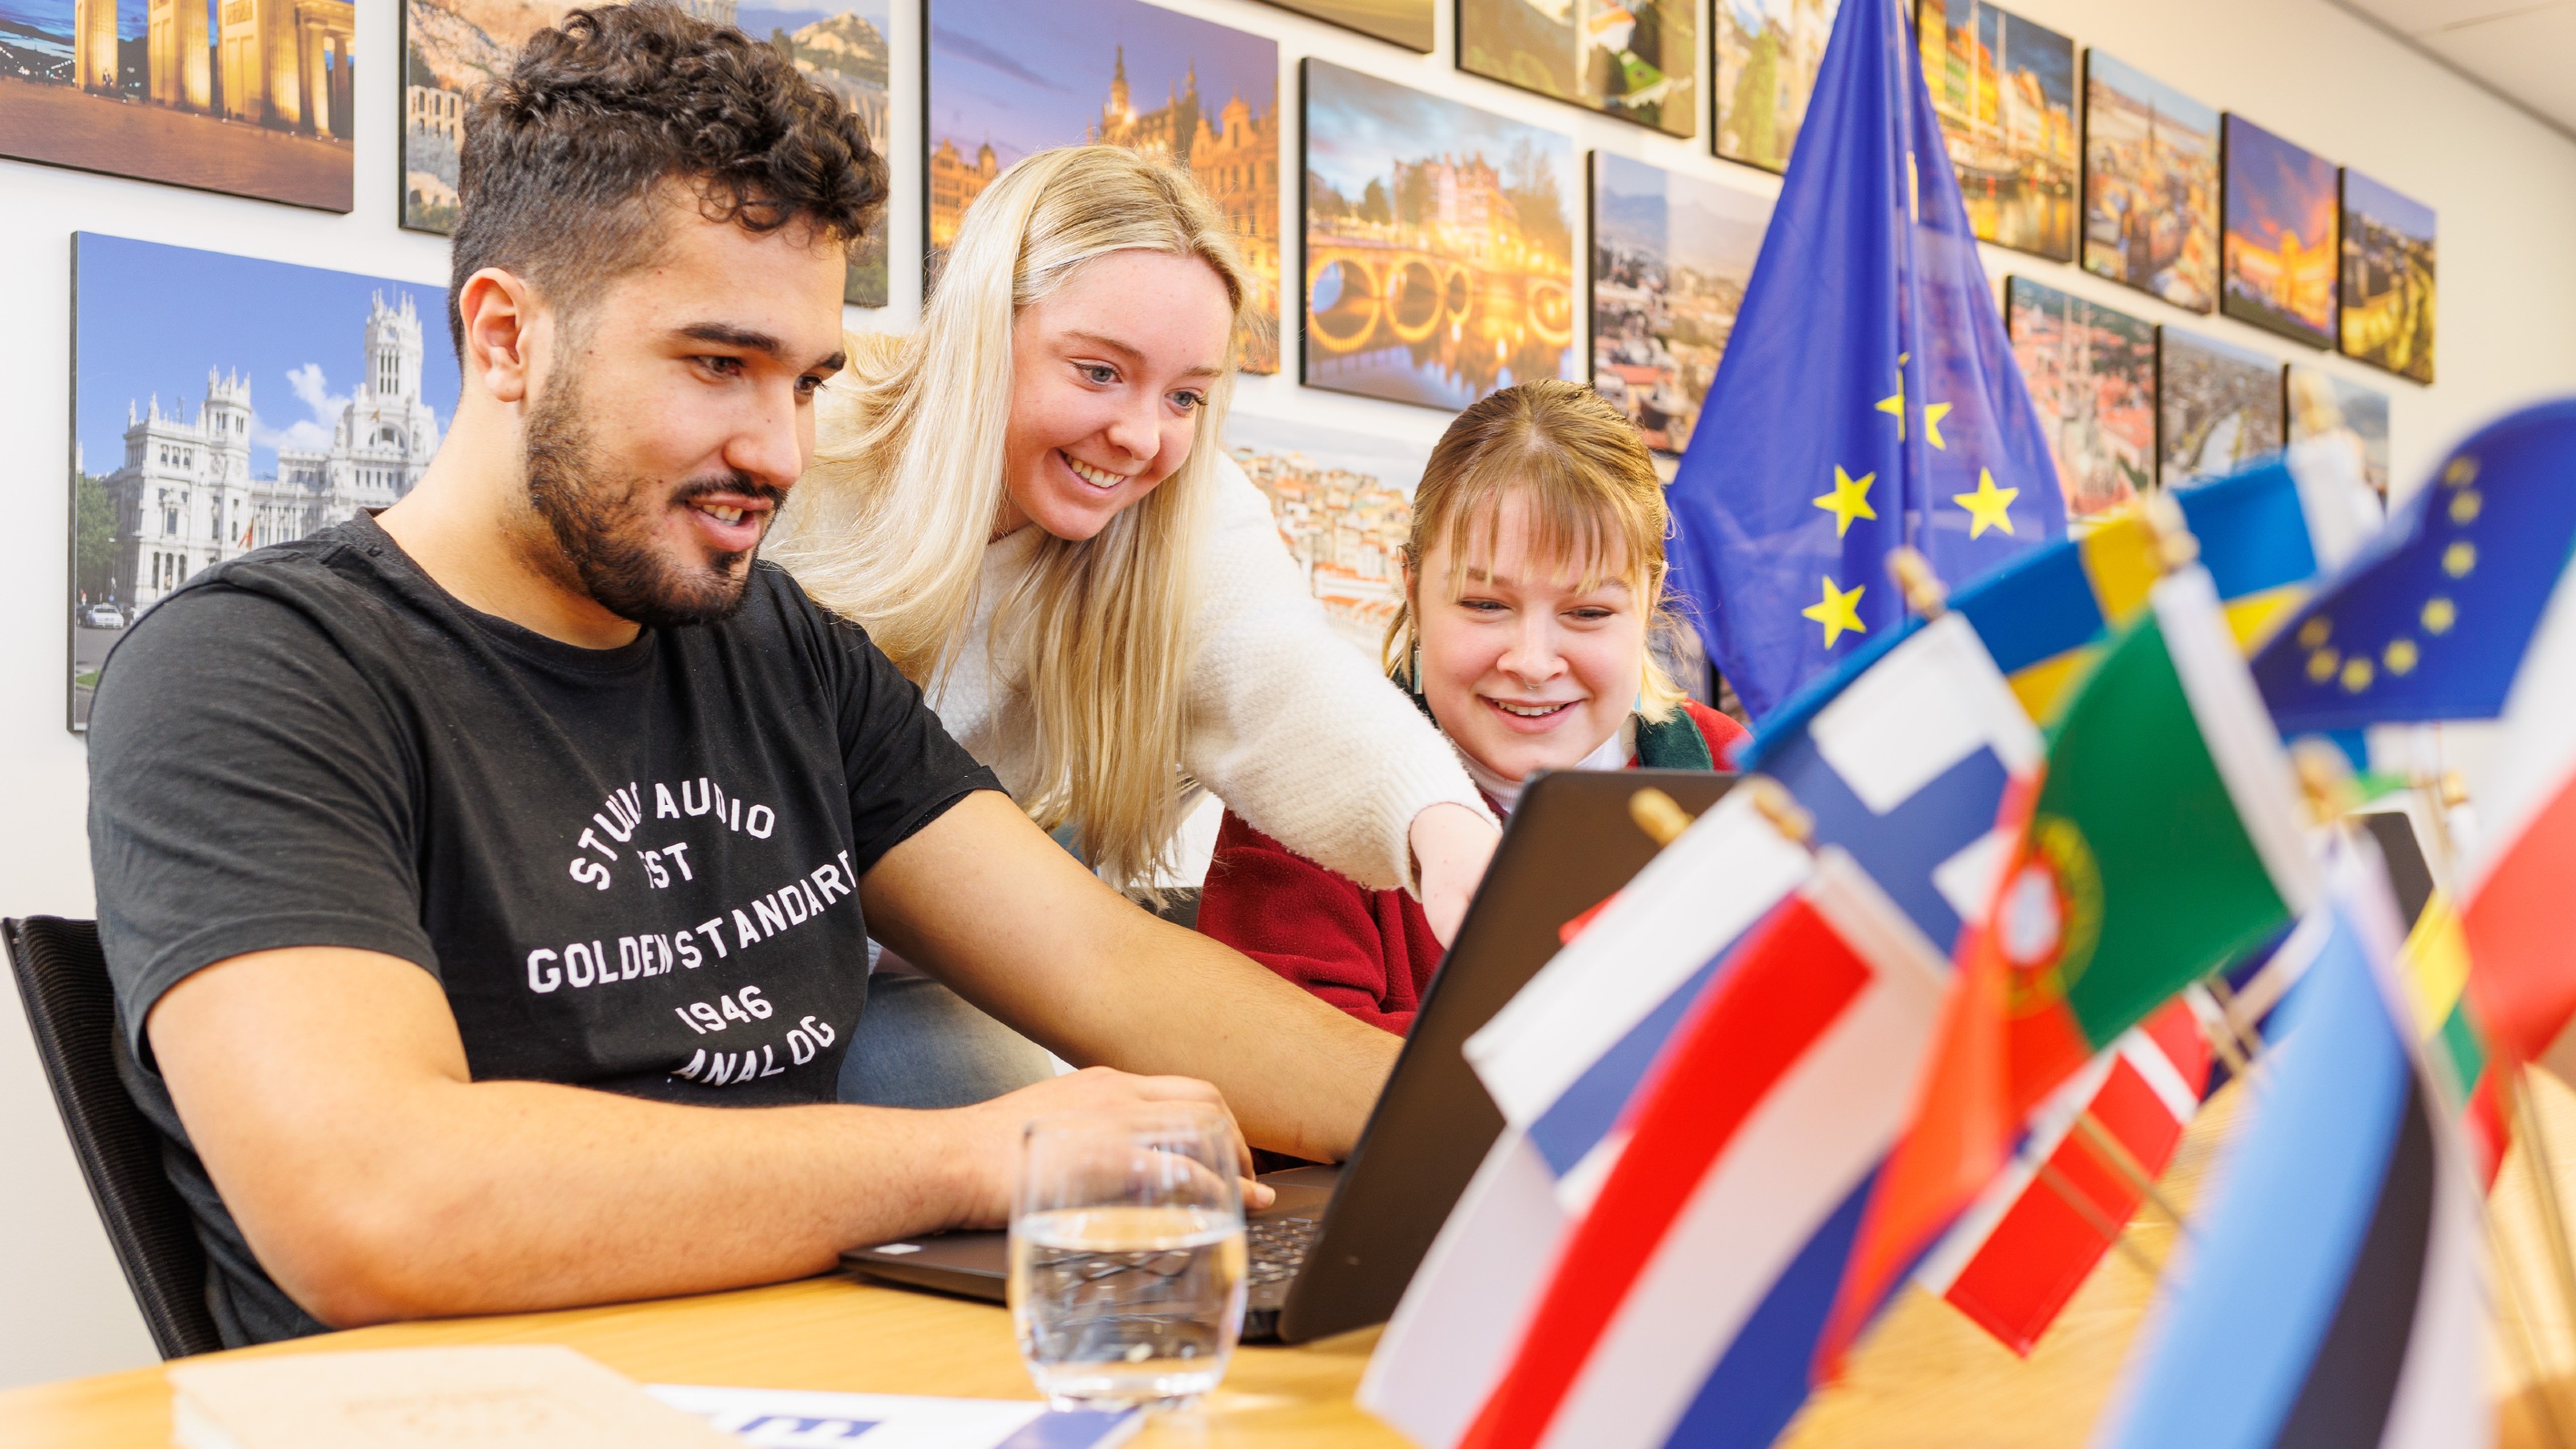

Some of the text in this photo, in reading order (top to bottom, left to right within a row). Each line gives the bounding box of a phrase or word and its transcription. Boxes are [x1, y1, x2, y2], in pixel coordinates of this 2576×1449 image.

[654, 777, 776, 840] AUDIO
[526, 934, 674, 993] GOLDEN
[675, 985, 773, 1034] 1946
[670, 1015, 836, 1087] ANALOG
